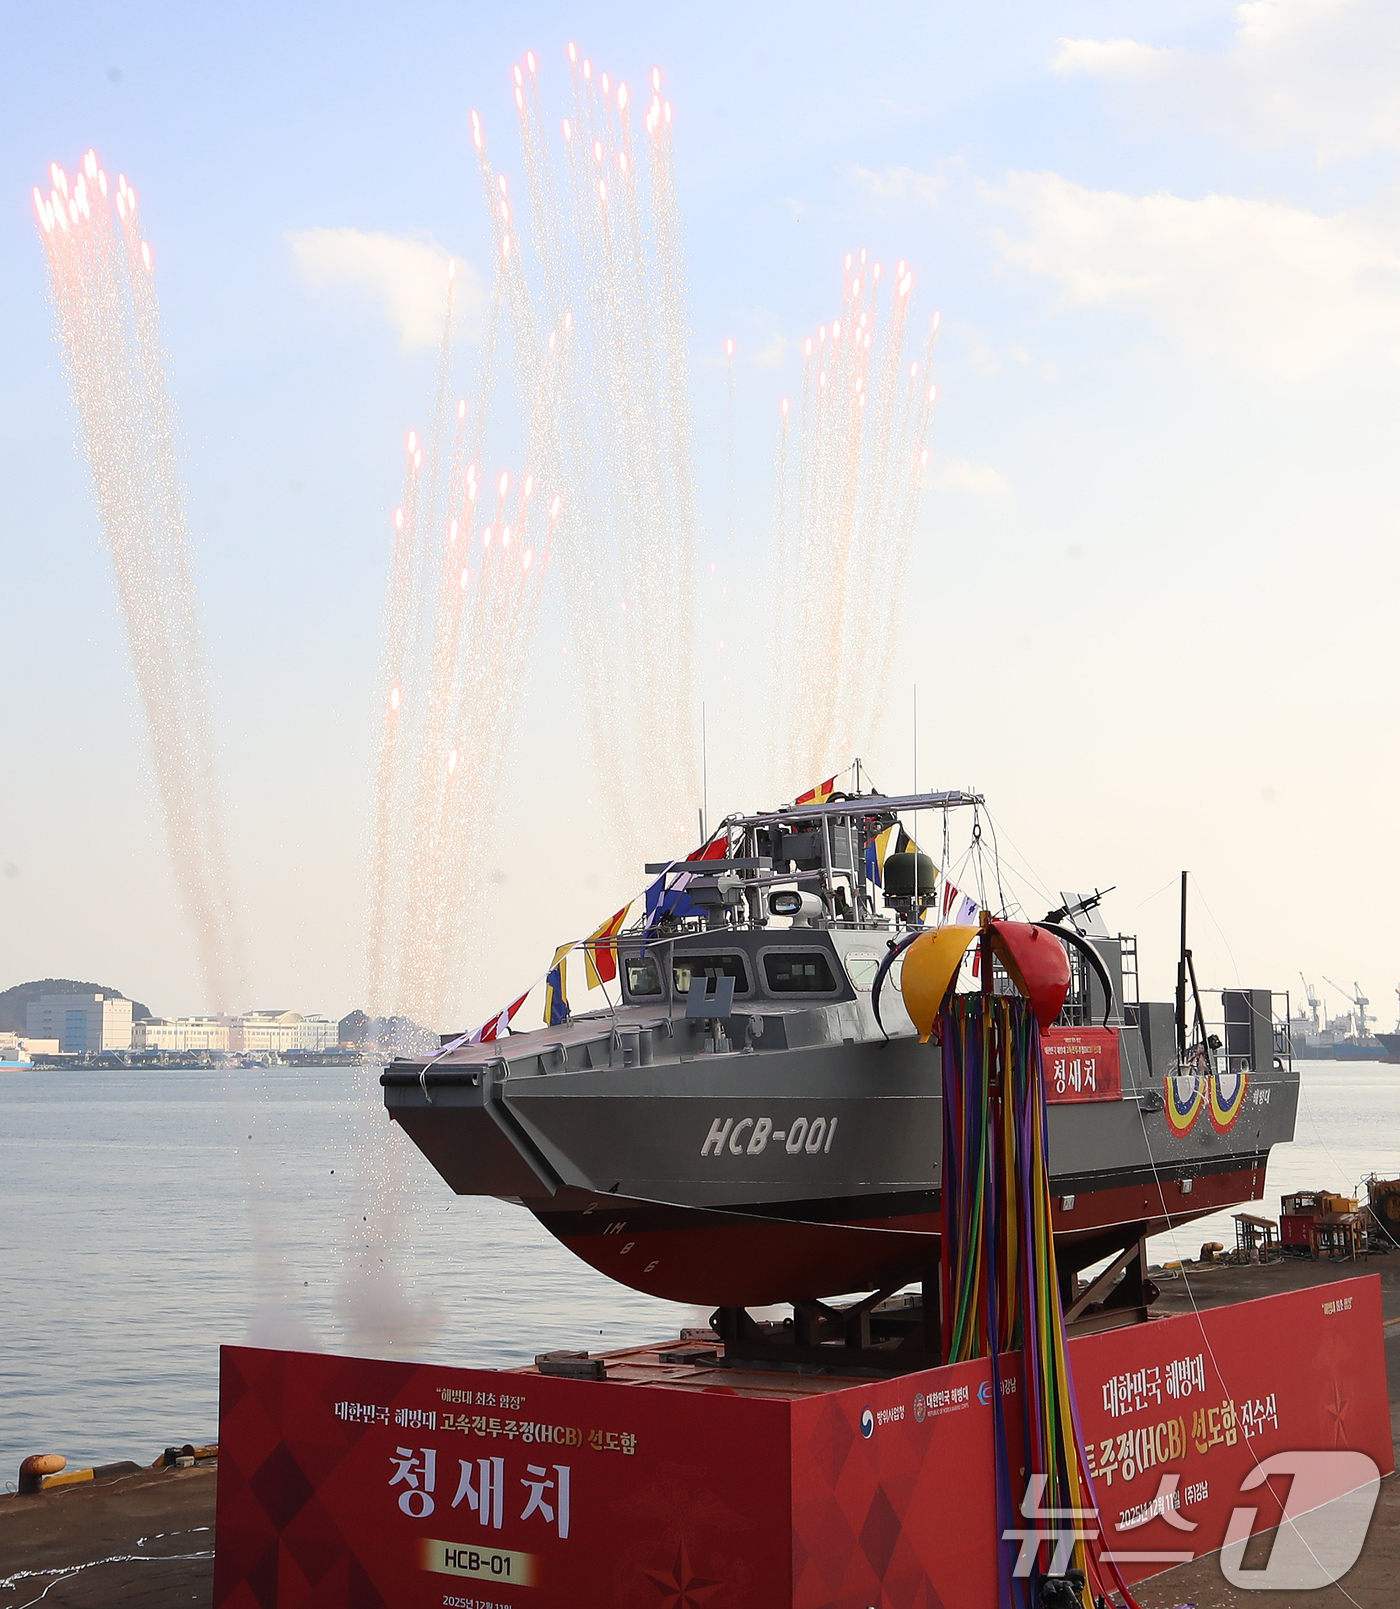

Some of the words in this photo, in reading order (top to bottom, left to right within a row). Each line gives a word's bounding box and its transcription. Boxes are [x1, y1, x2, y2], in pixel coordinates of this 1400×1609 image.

[1053, 1058, 1096, 1094] 청새치
[700, 1116, 838, 1156] HCB-001
[582, 1202, 598, 1215] 2
[619, 1241, 635, 1255] 8
[643, 1260, 660, 1273] 6
[475, 1391, 497, 1408] 최초
[925, 1390, 950, 1409] 대한민국
[950, 1385, 970, 1402] 해병대
[999, 1376, 1017, 1396] )강남
[1101, 1366, 1162, 1418] 대한민국
[1164, 1353, 1206, 1400] 해병대
[334, 1401, 391, 1426] 대한민국
[394, 1408, 437, 1431] 해병대
[440, 1413, 583, 1448] 고속전투주정(HCB)
[587, 1429, 638, 1456] 선도함
[876, 1404, 905, 1426] 방위사업청
[1191, 1399, 1238, 1455] 선도함
[1240, 1392, 1279, 1439] 진수식
[387, 1445, 571, 1540] 청새치
[1119, 1501, 1149, 1529] 2025년
[1165, 1489, 1181, 1511] 11일
[1184, 1479, 1209, 1506] (주)강남
[444, 1547, 511, 1577] HCB-01
